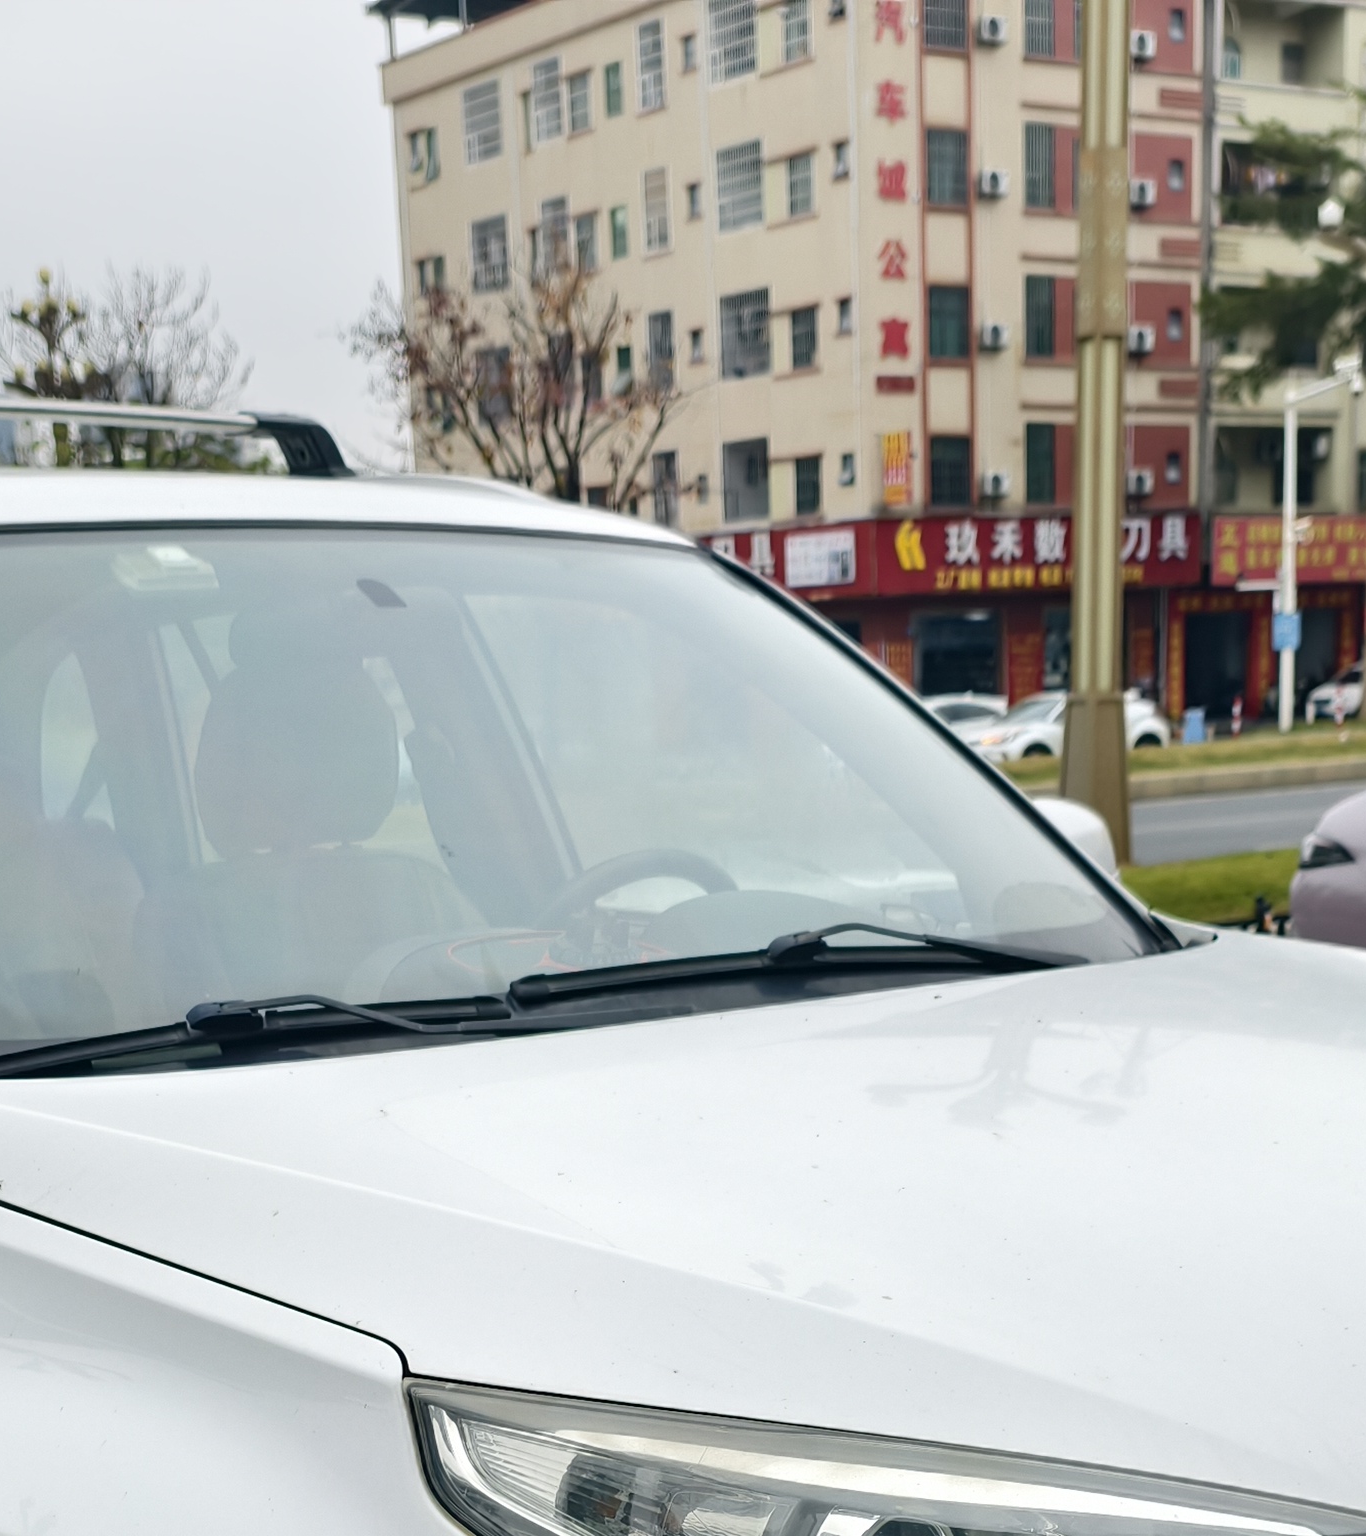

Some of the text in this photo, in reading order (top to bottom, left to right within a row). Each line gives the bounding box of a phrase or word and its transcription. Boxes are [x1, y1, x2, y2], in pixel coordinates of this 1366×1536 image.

[944, 513, 1188, 565] 玖禾数刀具
